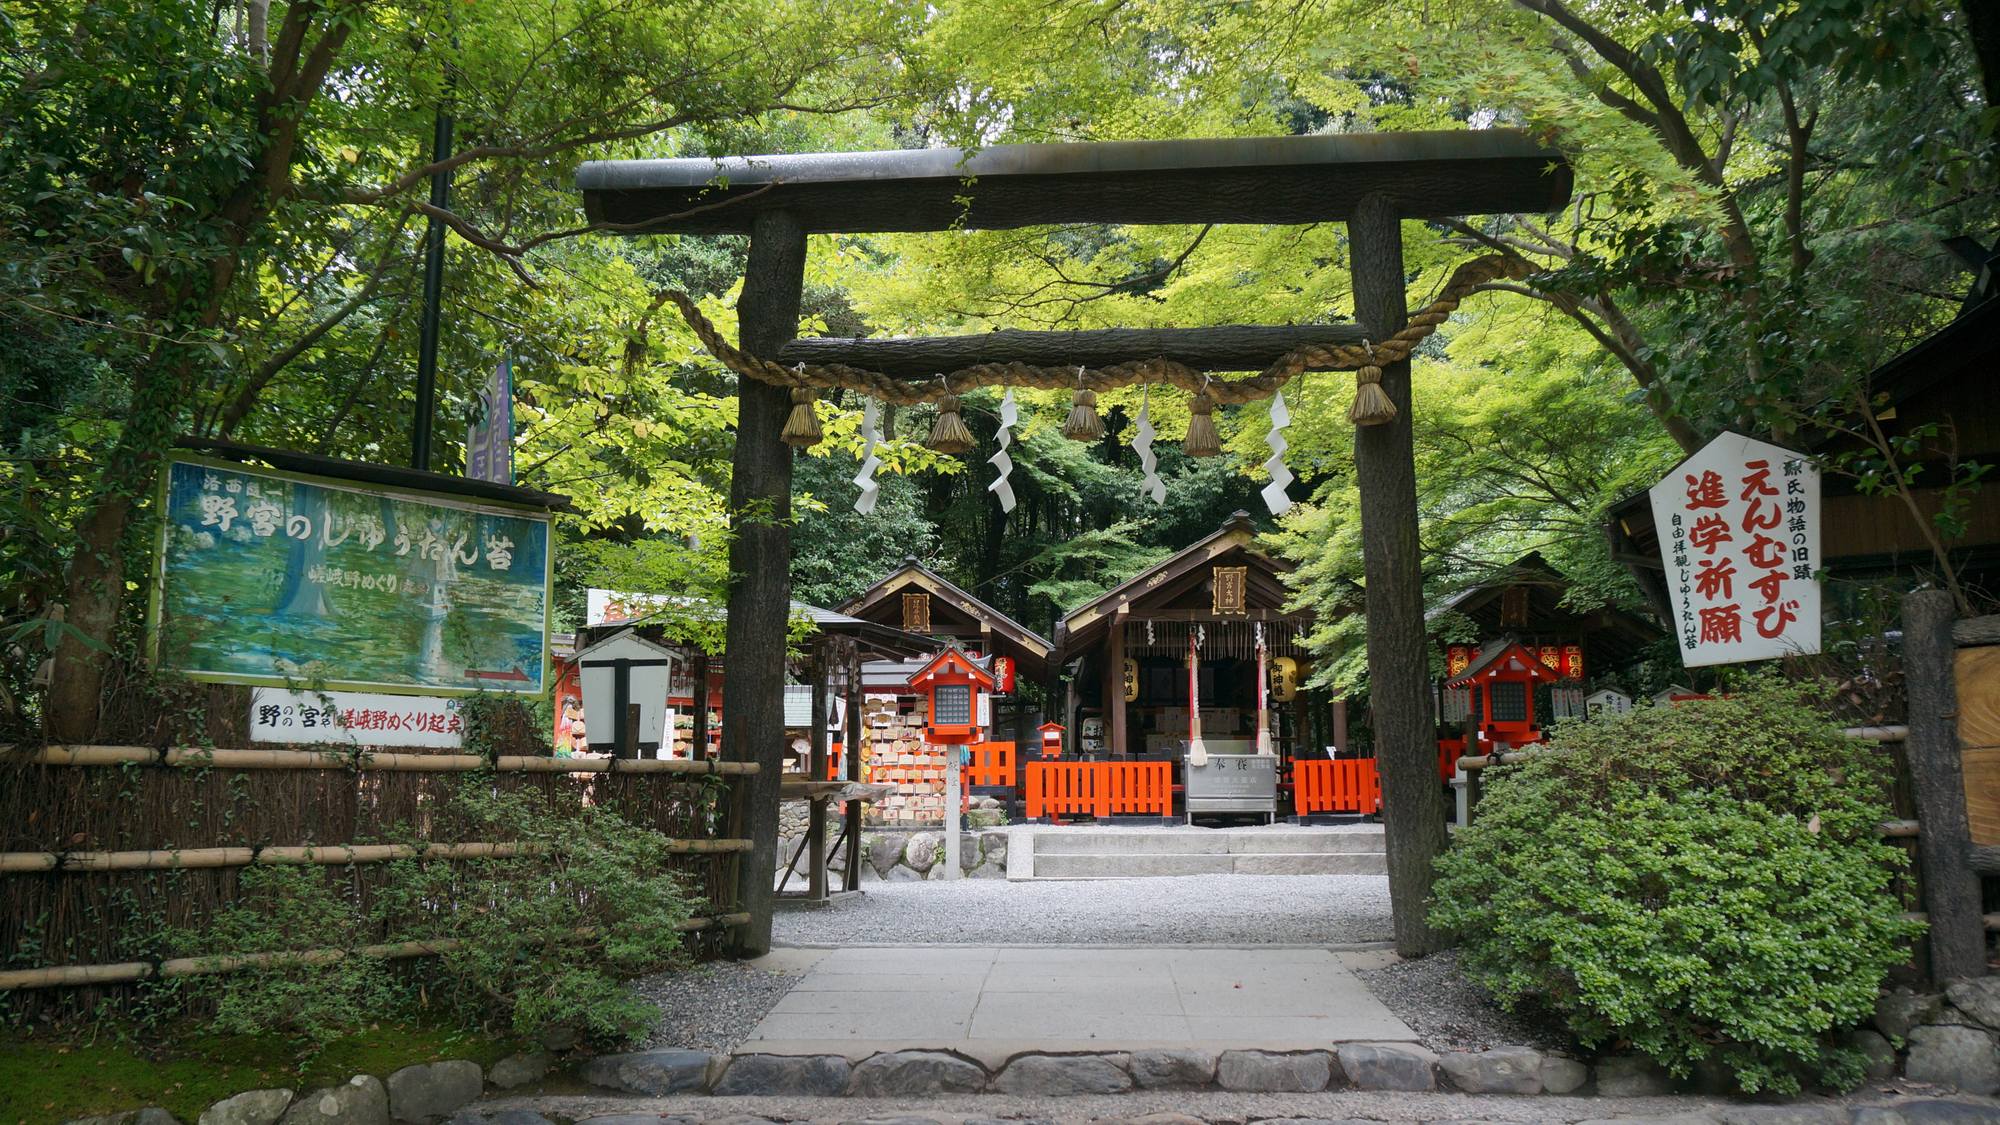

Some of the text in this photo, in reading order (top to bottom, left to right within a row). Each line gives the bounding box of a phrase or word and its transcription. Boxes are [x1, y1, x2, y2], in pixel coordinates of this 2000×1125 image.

[1685, 470, 1743, 645] 進学祈願
[1741, 459, 1800, 639] えんむすび
[1784, 459, 1812, 581] 源氏物語の旧蹟
